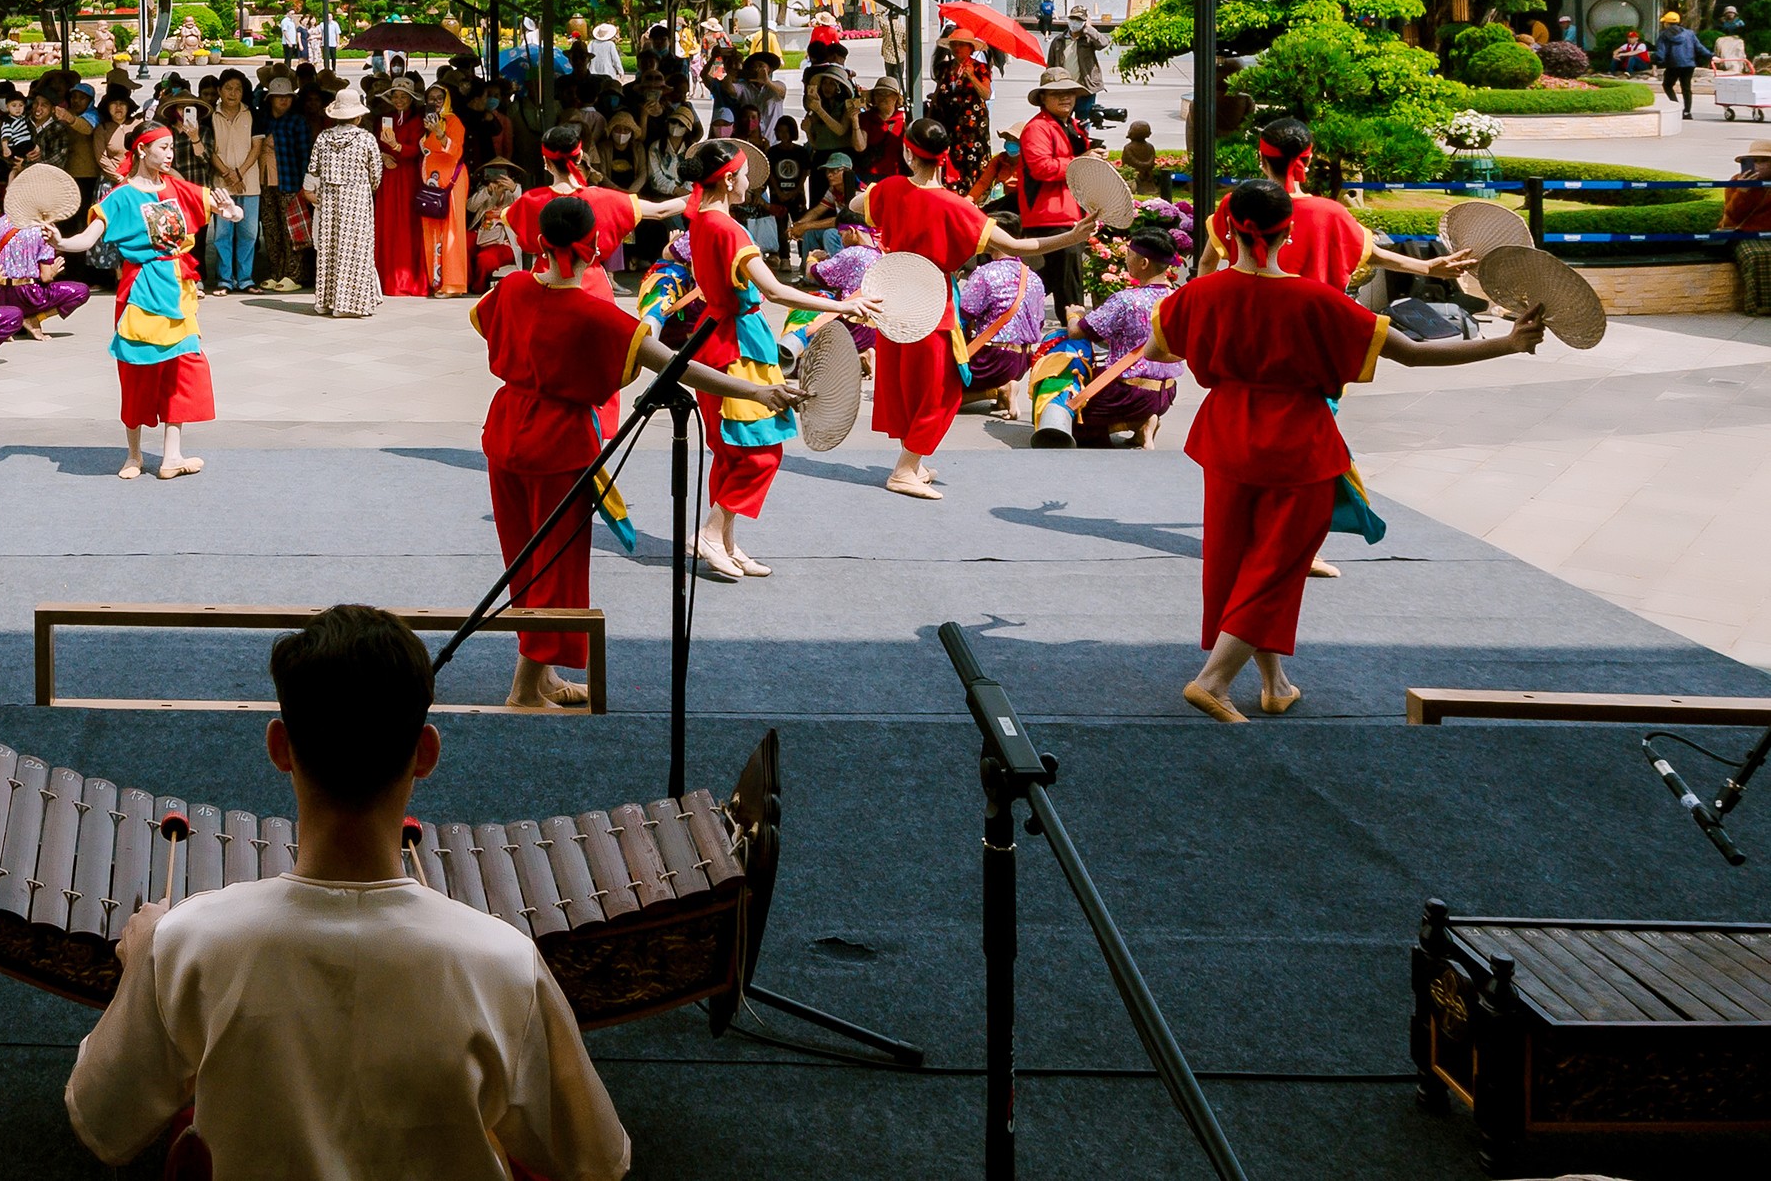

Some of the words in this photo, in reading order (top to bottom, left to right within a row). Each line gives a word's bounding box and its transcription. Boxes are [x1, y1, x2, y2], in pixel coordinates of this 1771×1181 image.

[24, 759, 44, 769] 20
[62, 770, 74, 780] 19
[94, 780, 107, 790] 18
[130, 790, 147, 800] 17
[164, 799, 177, 809] 16
[659, 800, 671, 808] 2
[198, 806, 215, 817] 15
[235, 812, 252, 822] 14
[520, 821, 529, 830] 6
[1463, 928, 1481, 937] 21
